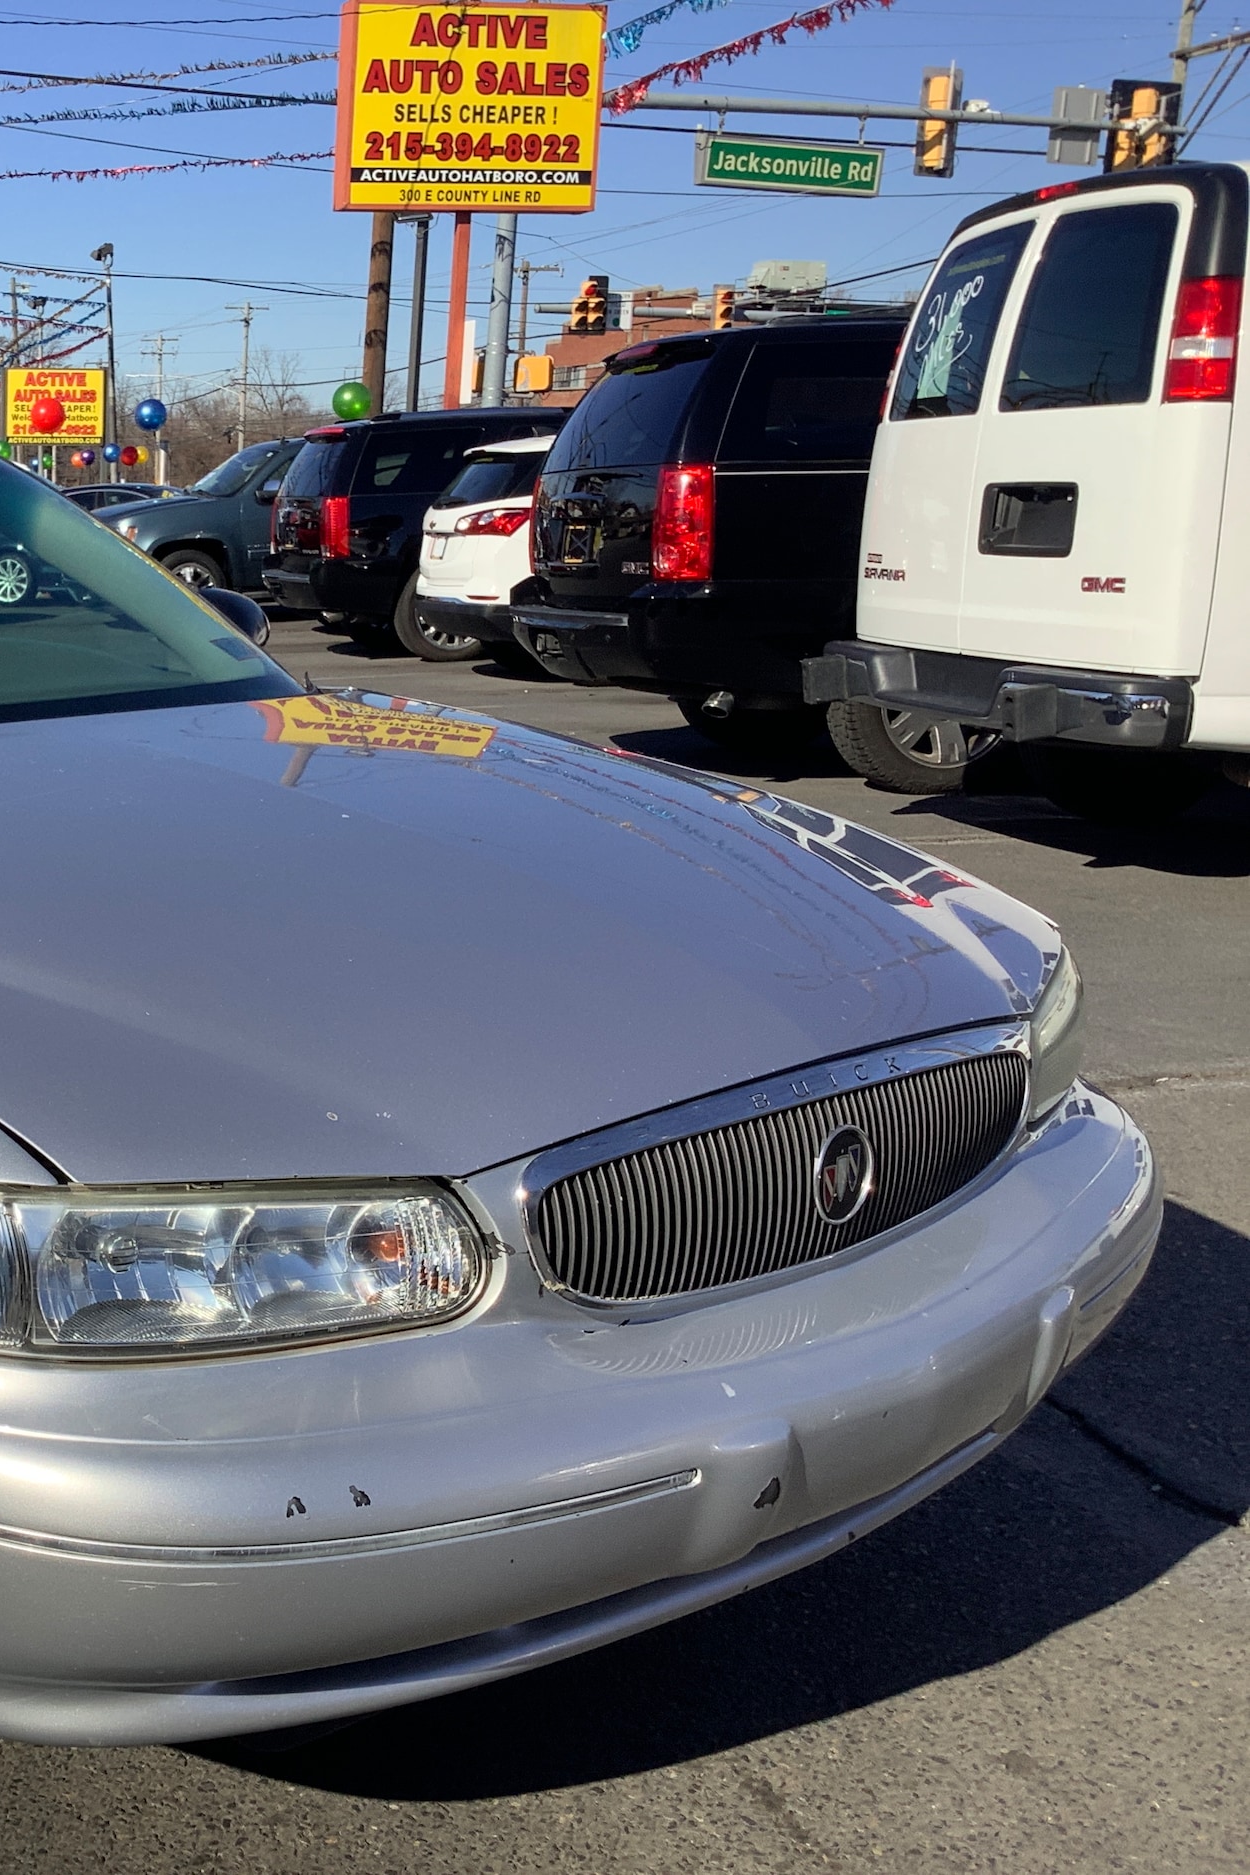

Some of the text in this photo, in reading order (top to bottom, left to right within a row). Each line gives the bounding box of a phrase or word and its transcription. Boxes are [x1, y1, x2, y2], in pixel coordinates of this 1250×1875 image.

[410, 13, 548, 49] ACTIVE
[362, 59, 590, 97] AUTO SALES
[394, 104, 452, 124] SELLS
[459, 105, 546, 125] CHEAPER
[364, 131, 581, 163] 215-394-8922
[359, 168, 581, 184] ACTIVEAUTOHATBORO.COM
[713, 151, 874, 183] Jacksonville Rd
[399, 189, 541, 203] 300 E COUNTY LINE RD
[24, 371, 87, 387] ACTIVE
[13, 389, 97, 404] AUTO SALES
[1081, 577, 1126, 593] GMC
[749, 1056, 902, 1109] BUICK
